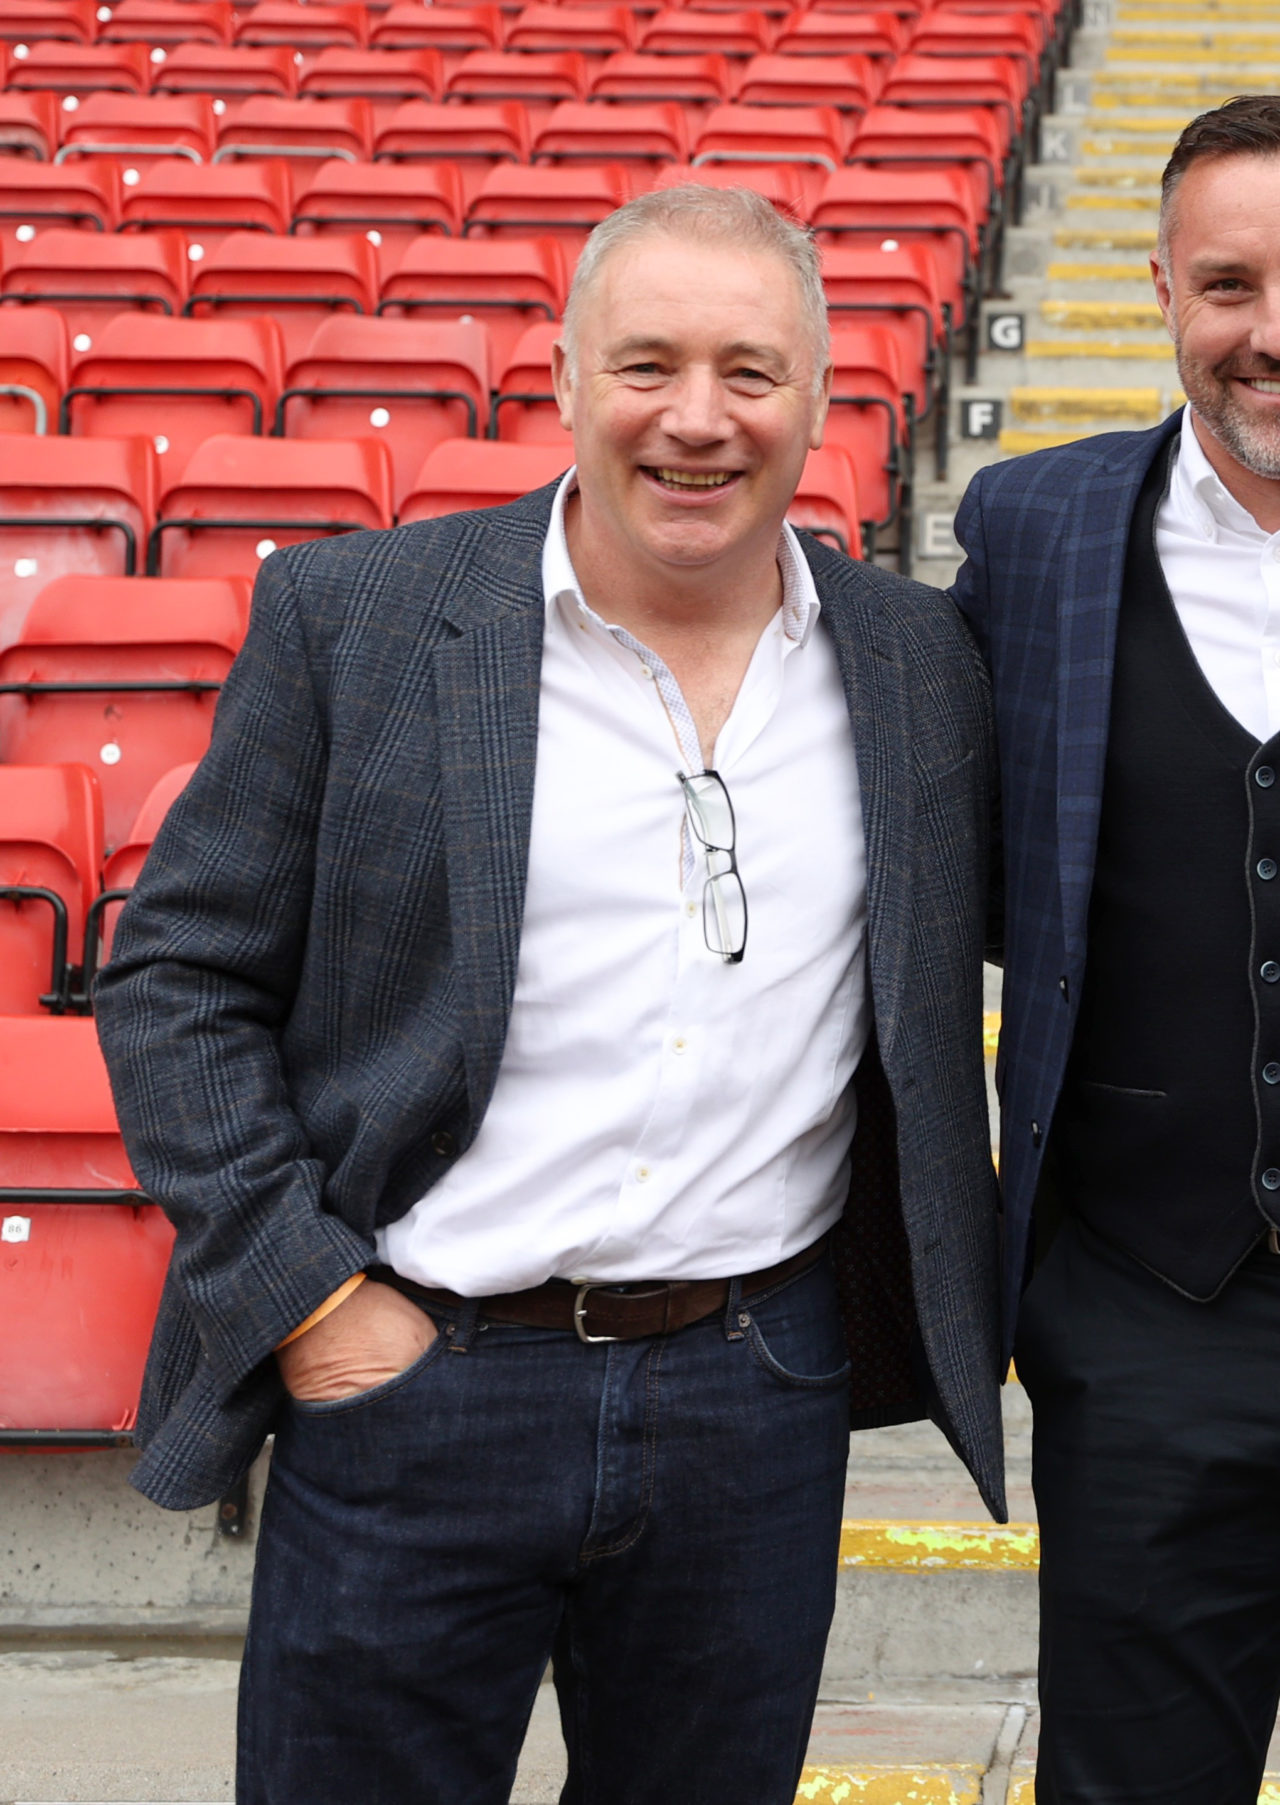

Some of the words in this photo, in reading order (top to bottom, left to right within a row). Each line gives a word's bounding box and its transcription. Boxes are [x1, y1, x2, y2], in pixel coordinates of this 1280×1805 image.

[1063, 84, 1087, 112] L
[1043, 130, 1067, 159] K
[991, 316, 1021, 348] G
[968, 402, 993, 436] F
[926, 513, 954, 555] E
